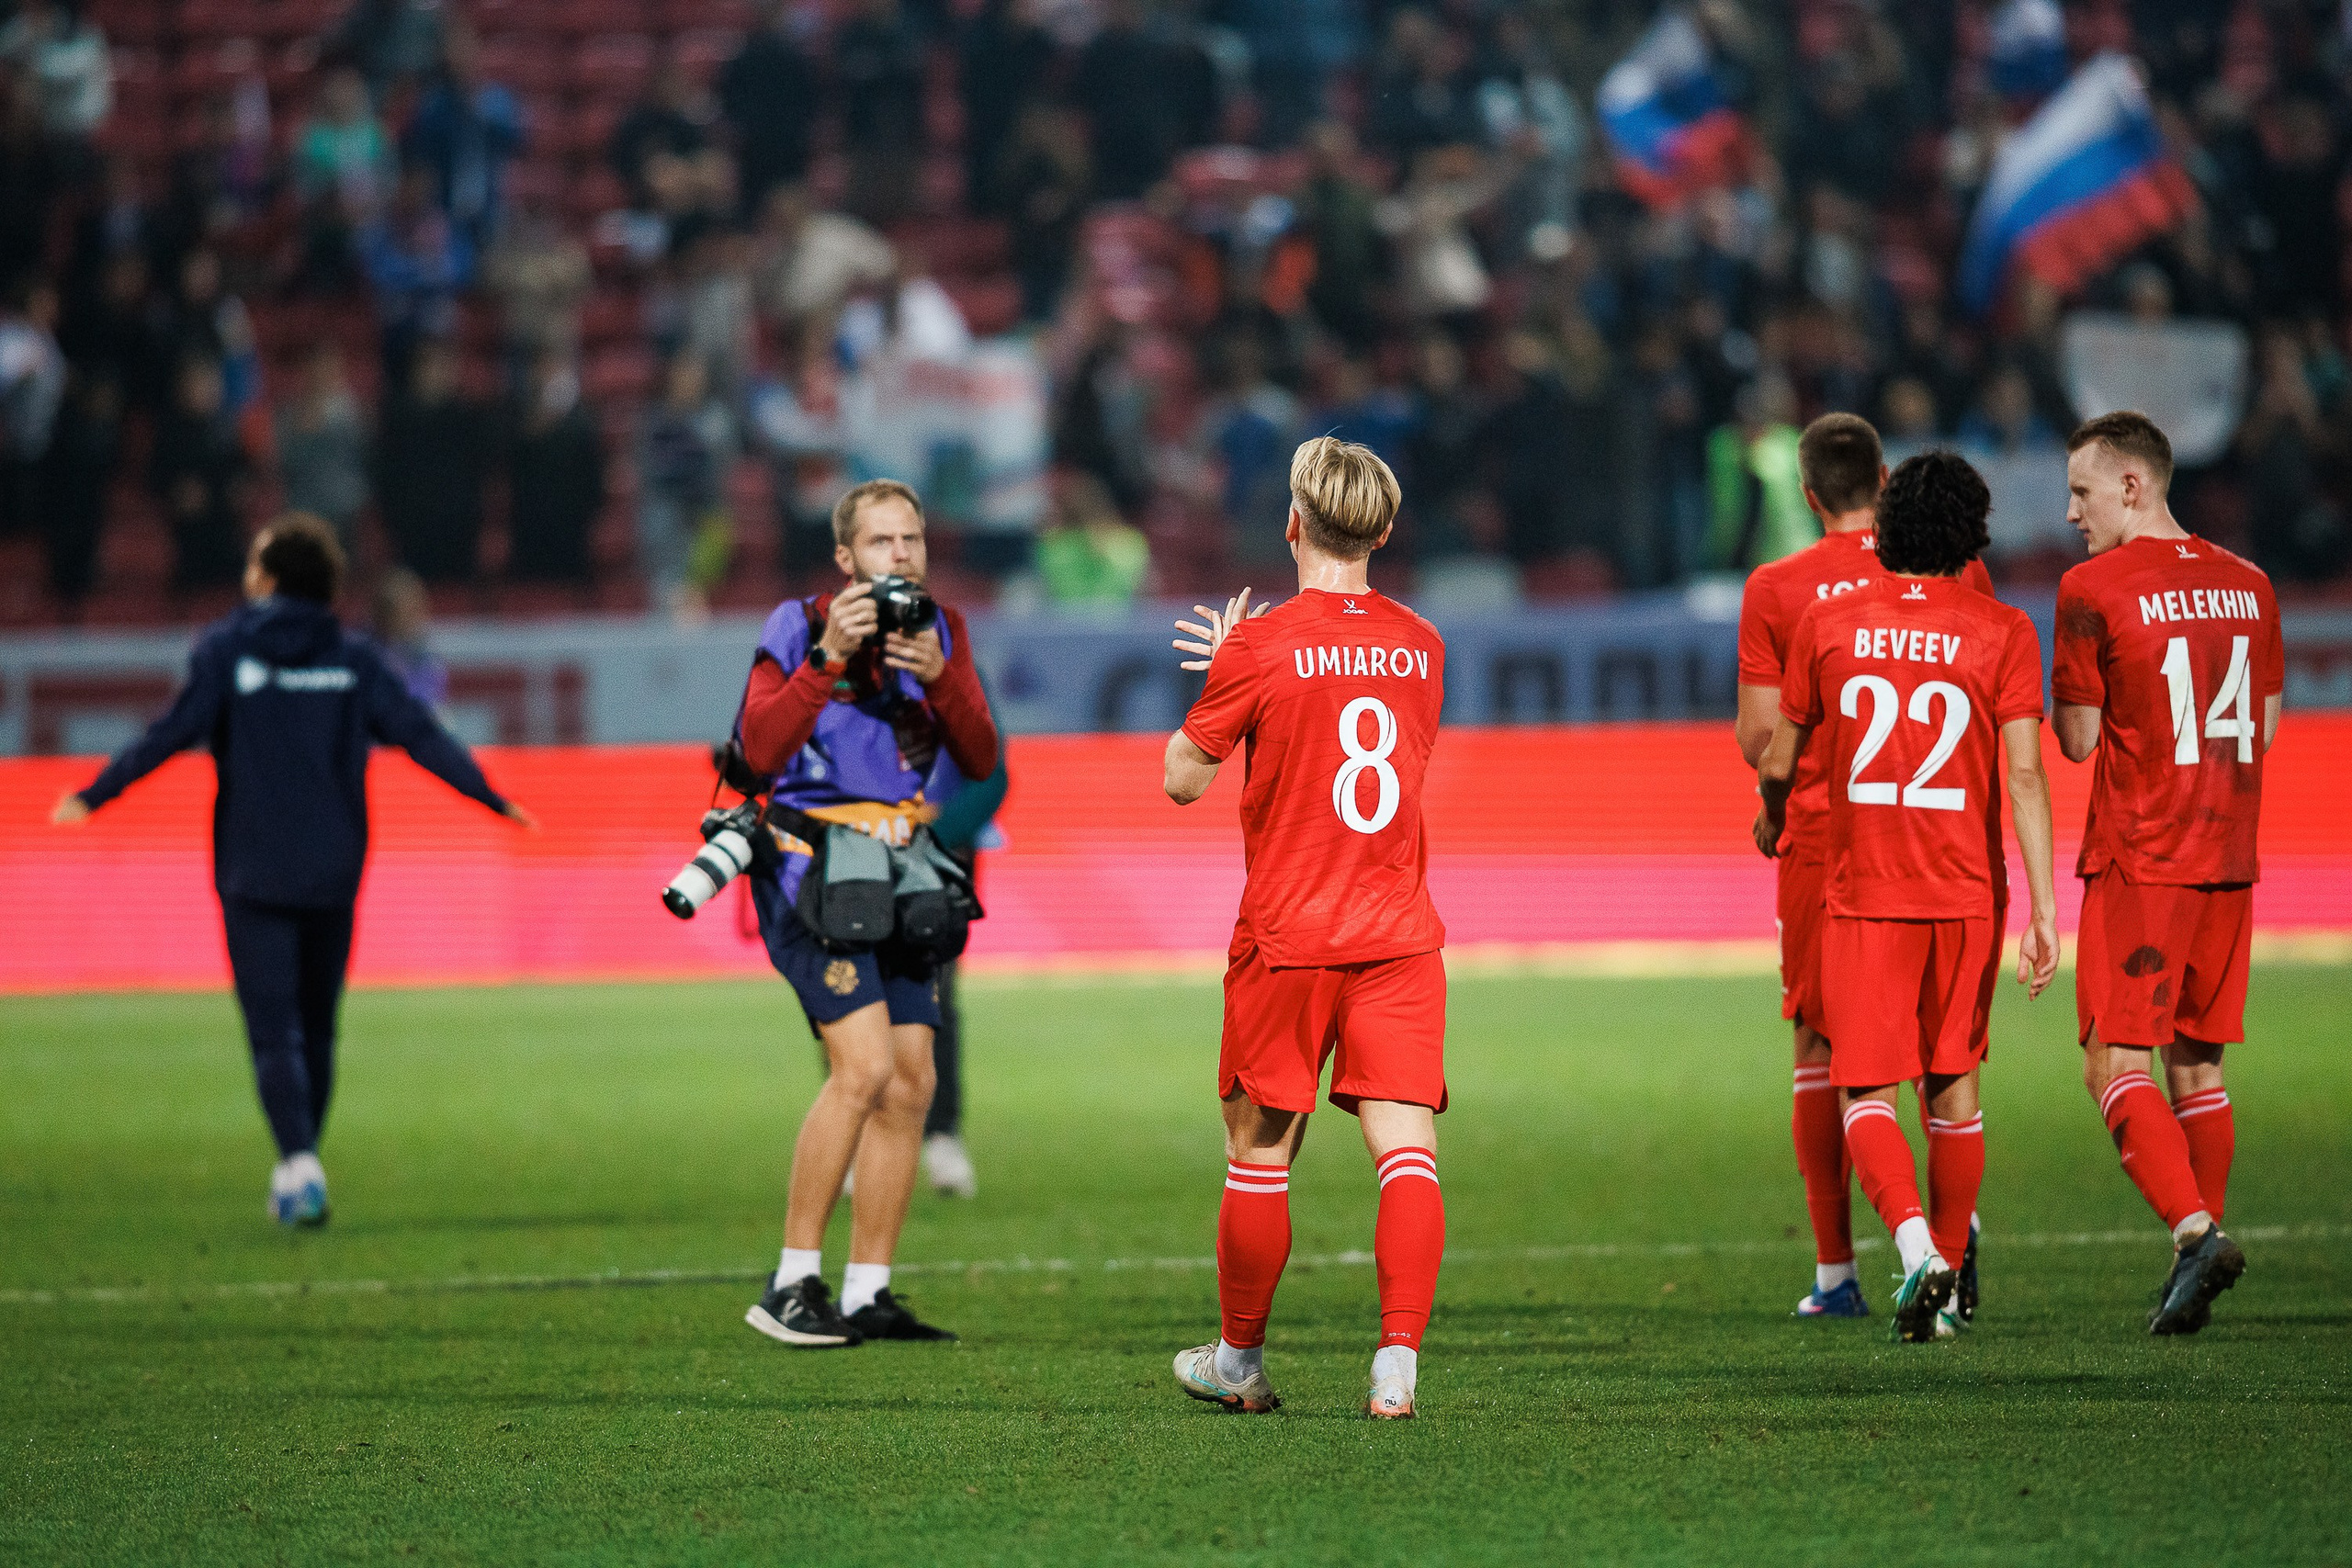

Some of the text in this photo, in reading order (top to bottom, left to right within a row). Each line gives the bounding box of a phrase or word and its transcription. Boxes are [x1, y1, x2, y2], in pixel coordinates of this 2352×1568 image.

[1854, 627, 1962, 665] BEVEEV
[2138, 589, 2259, 626] MELEKHIN
[1294, 646, 1428, 680] UMIAROV
[2159, 635, 2256, 765] 14
[1332, 696, 1400, 834] 8
[1839, 674, 1971, 811] 22
